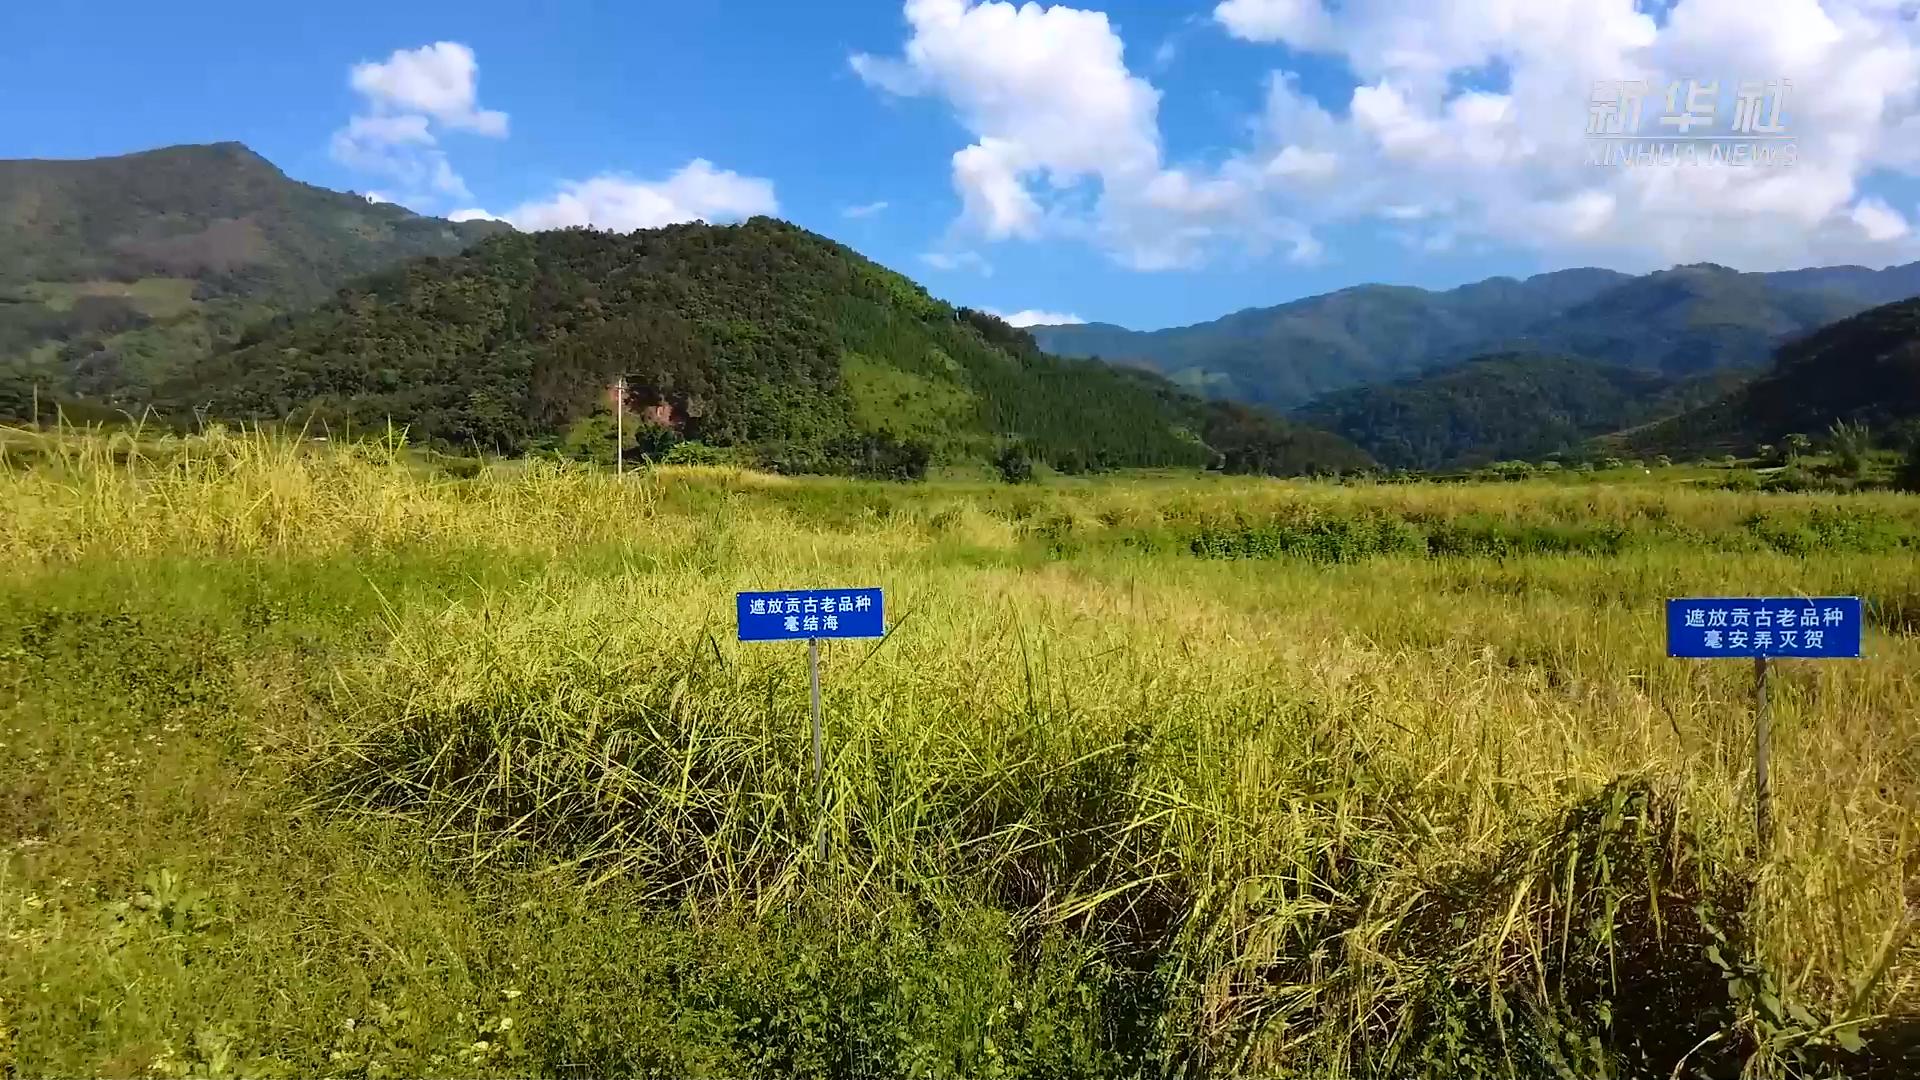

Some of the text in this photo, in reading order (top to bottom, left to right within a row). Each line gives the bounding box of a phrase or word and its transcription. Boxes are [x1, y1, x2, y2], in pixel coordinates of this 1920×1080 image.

[749, 595, 872, 615] 遮放贡古老品种
[783, 615, 839, 632] 毫结海
[1684, 607, 1844, 627] 遮放贡古老品种
[1704, 629, 1824, 649] 毫安弄灭贺
